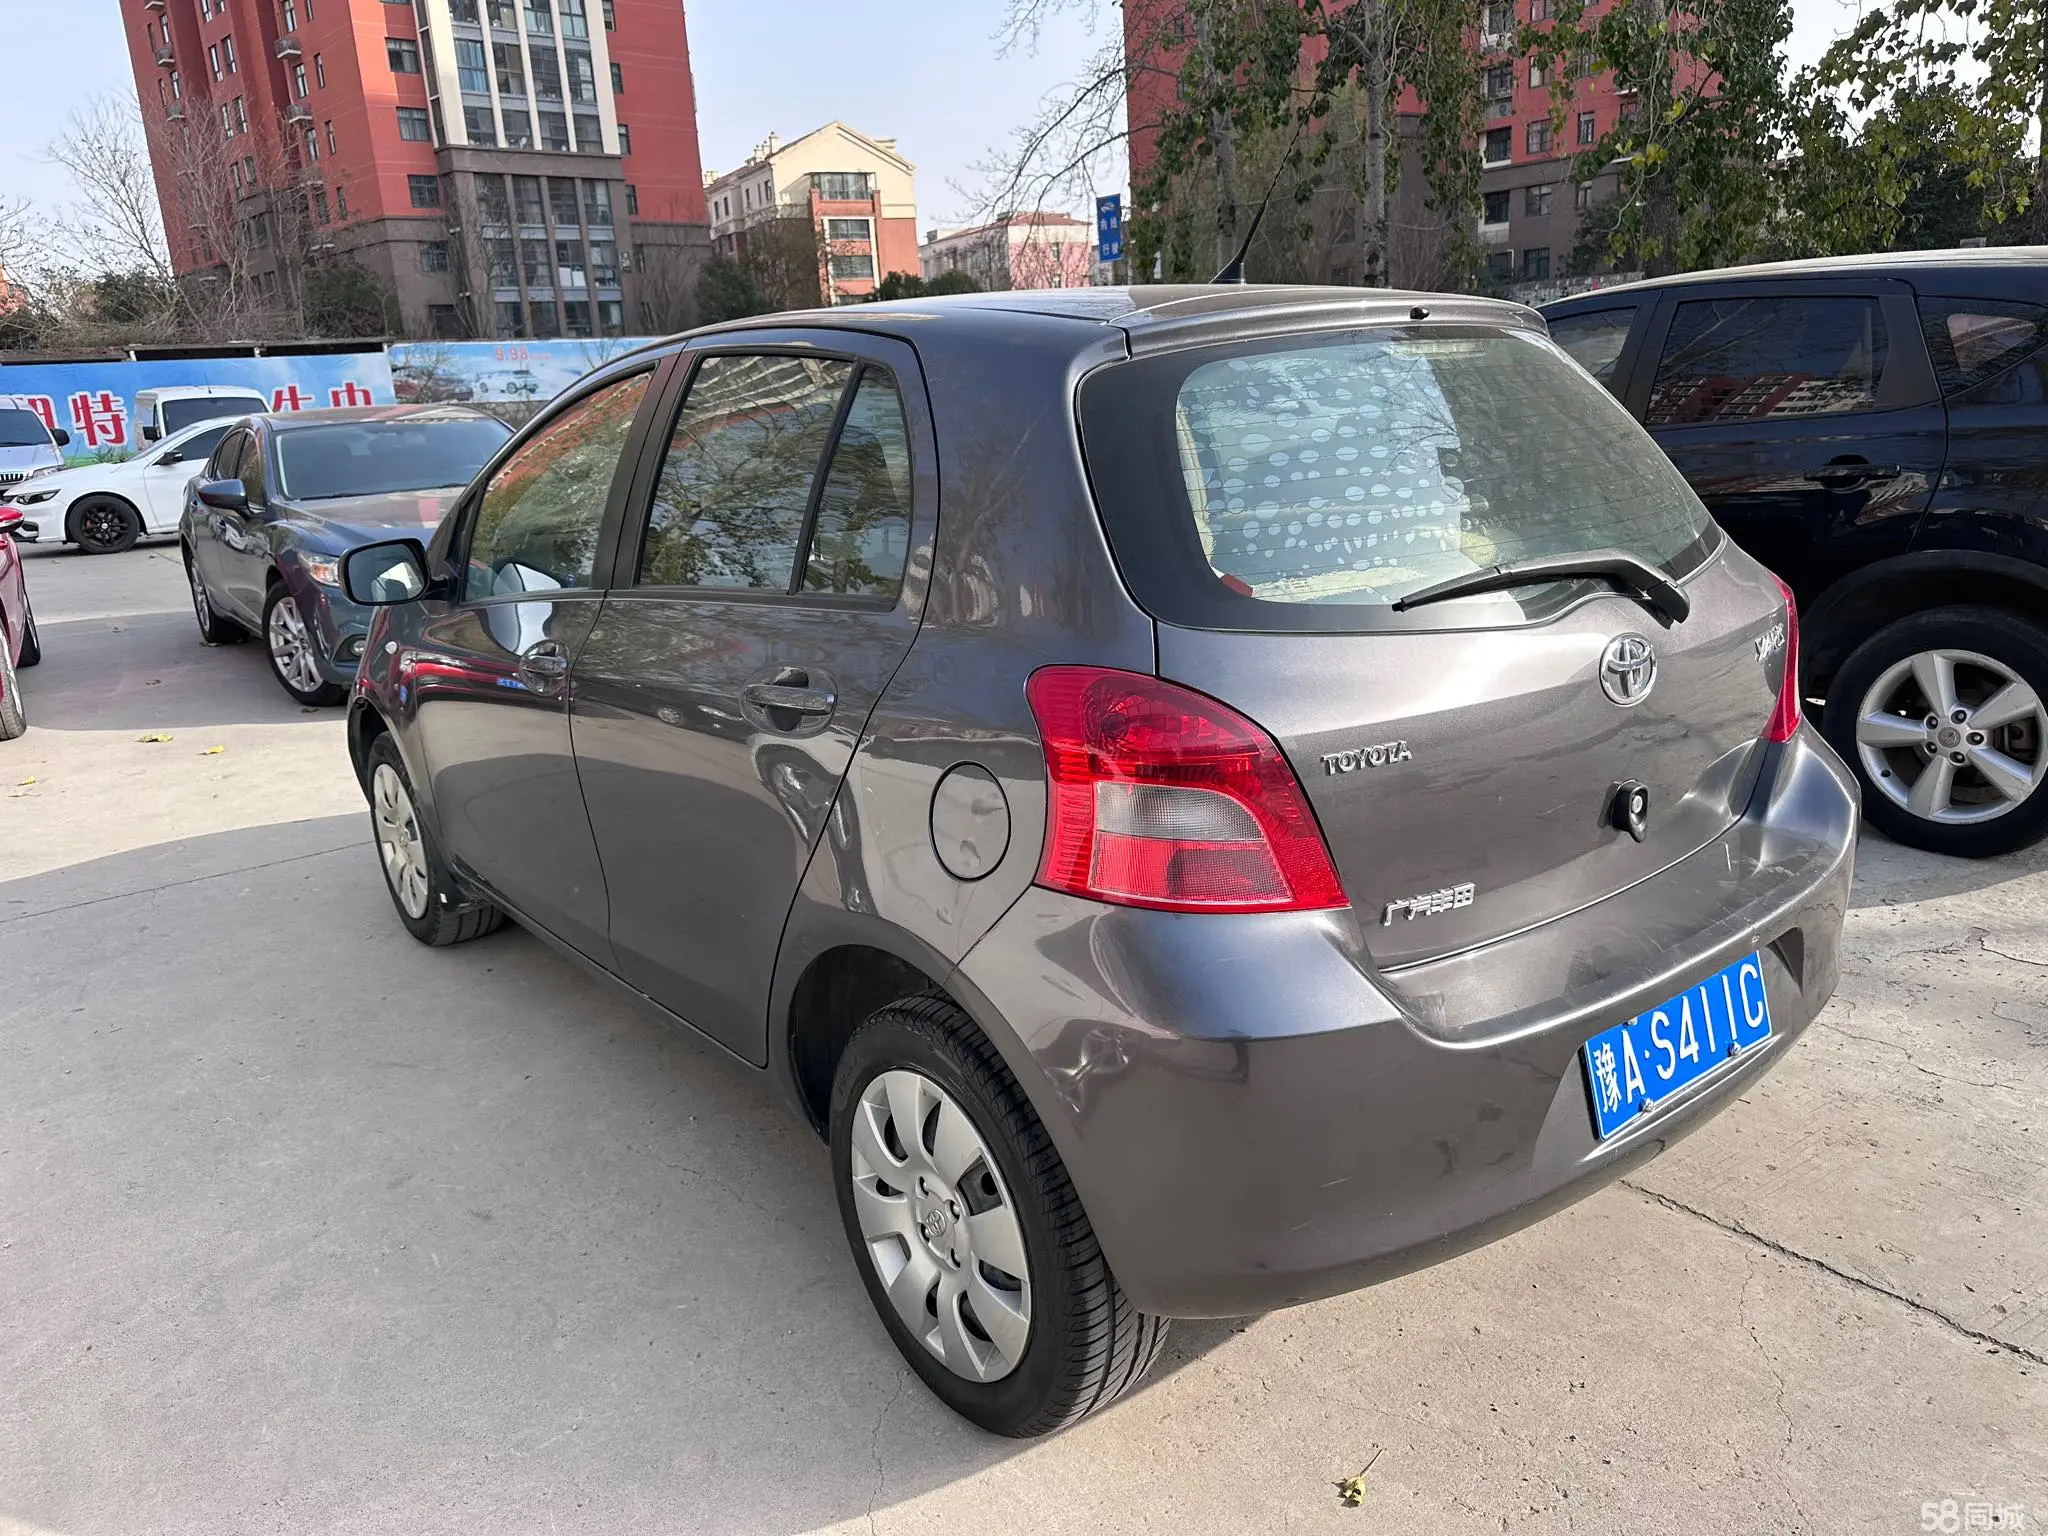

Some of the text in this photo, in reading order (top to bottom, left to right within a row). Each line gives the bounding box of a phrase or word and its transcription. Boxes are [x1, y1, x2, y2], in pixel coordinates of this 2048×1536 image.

[1321, 740, 1413, 775] TOYOTA
[1381, 881, 1476, 927] 广汽丰田
